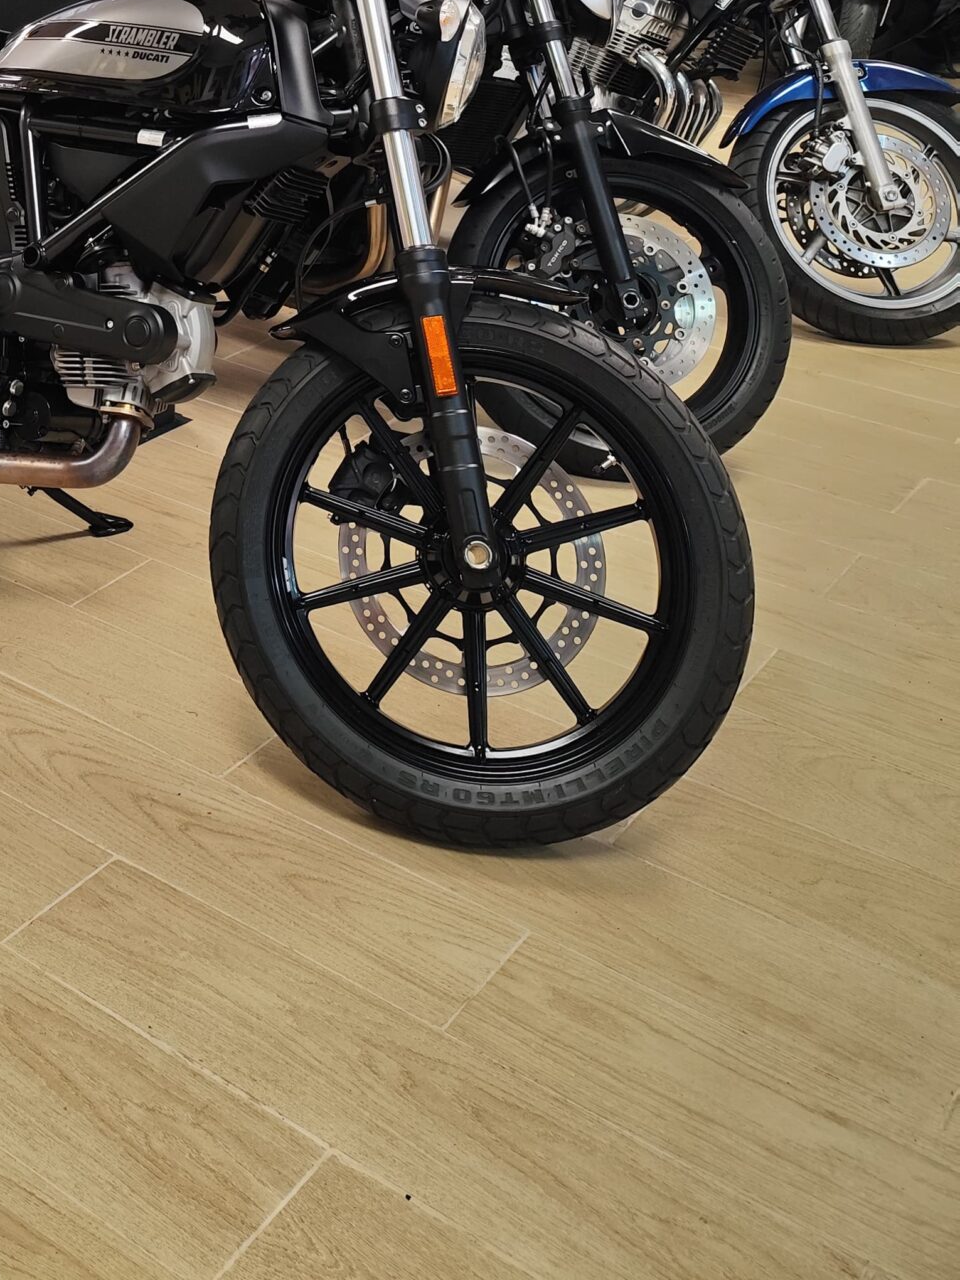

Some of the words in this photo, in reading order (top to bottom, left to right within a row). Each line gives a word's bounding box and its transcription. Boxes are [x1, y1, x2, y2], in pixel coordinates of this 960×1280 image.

[105, 25, 180, 50] SCRAMBLER
[132, 51, 170, 63] DUCATI
[547, 240, 568, 267] TOKICO
[553, 718, 667, 800] PIRELLI
[452, 787, 545, 806] MT60
